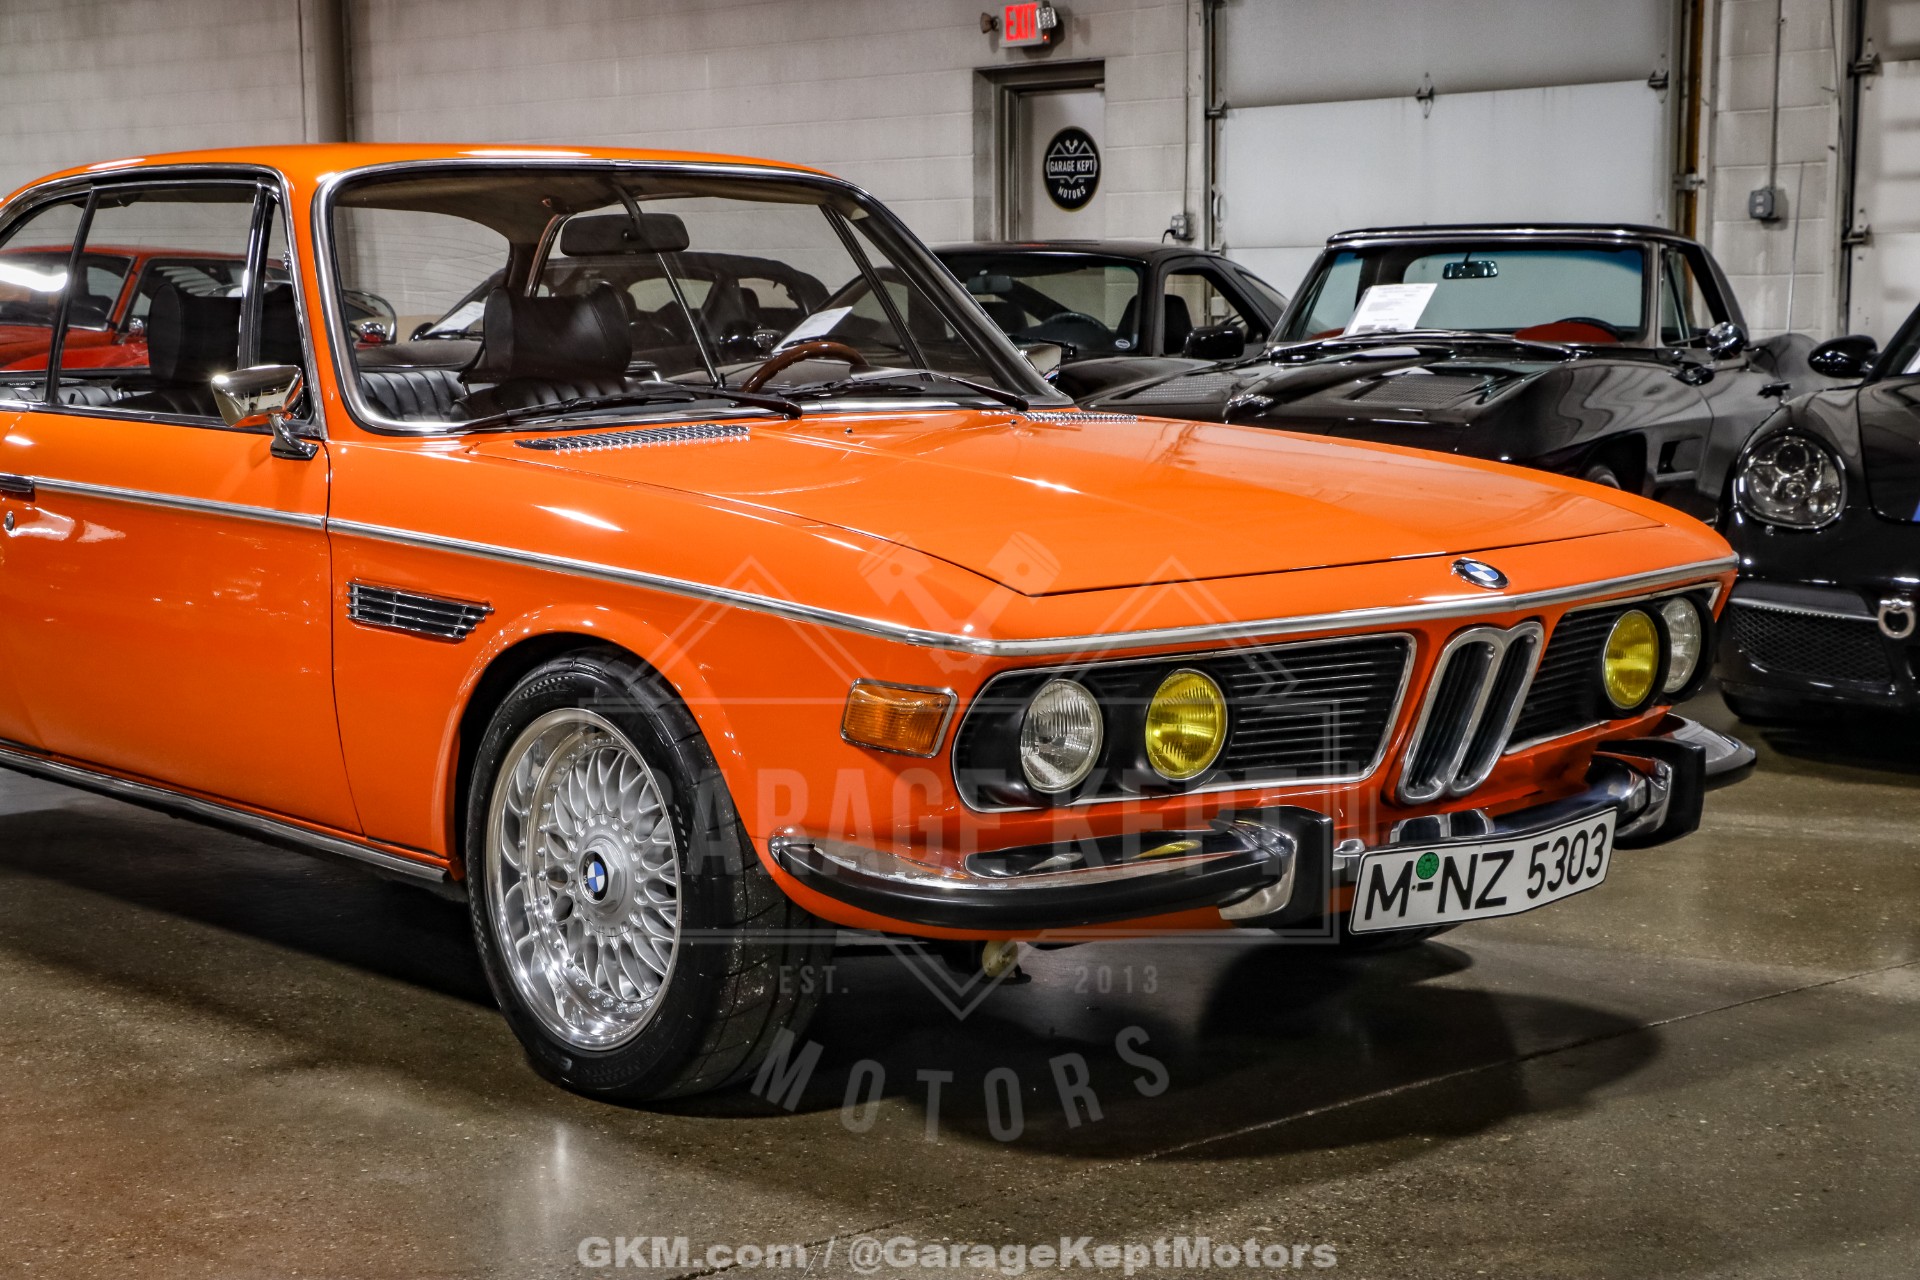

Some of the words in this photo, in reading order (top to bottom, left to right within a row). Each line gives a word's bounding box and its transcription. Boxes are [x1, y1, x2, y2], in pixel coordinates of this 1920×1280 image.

[1005, 3, 1038, 41] EXIT
[1050, 161, 1075, 172] GARAGE
[1076, 160, 1093, 171] KEPT
[1058, 185, 1086, 199] MOTORS
[1527, 822, 1608, 899] 5303
